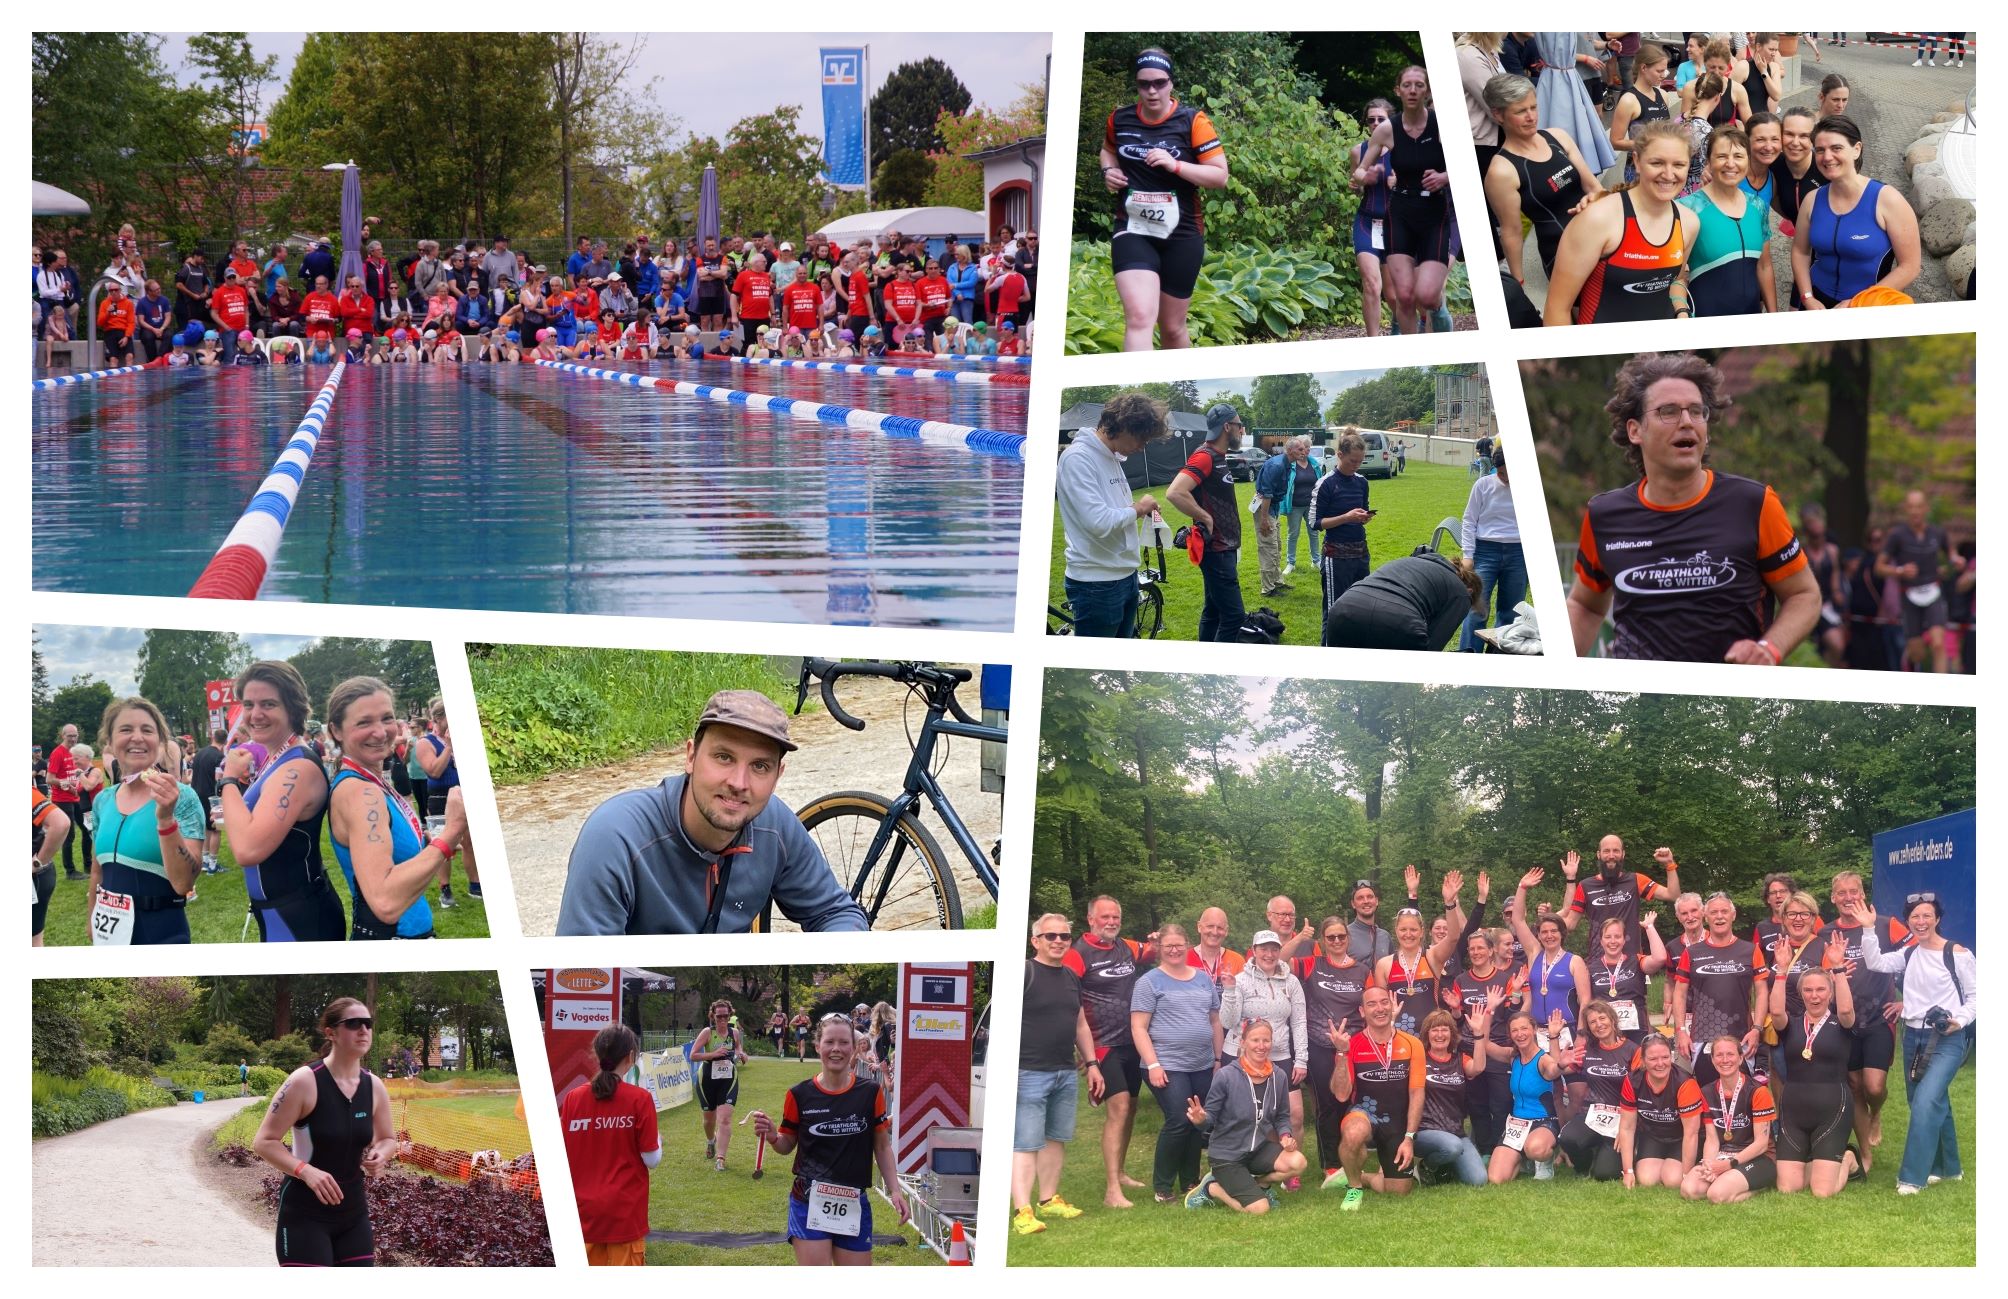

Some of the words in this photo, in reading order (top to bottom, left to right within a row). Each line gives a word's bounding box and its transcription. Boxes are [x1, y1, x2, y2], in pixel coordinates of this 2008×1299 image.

[1140, 208, 1165, 222] 422
[1605, 540, 1653, 551] triathlon.one
[1632, 571, 1647, 581] PV
[1649, 567, 1712, 580] TRIATHLON
[1658, 578, 1673, 588] TG
[1675, 576, 1718, 587] WITTEN
[95, 911, 120, 935] 527
[571, 1012, 610, 1023] Vogedes
[1617, 1010, 1630, 1019] 22
[568, 1118, 592, 1132] DT
[594, 1116, 635, 1130] SWISS
[1595, 1114, 1614, 1125] 527
[1506, 1127, 1522, 1139] 506
[817, 1184, 856, 1198] REMONDIS
[822, 1200, 848, 1217] 516
